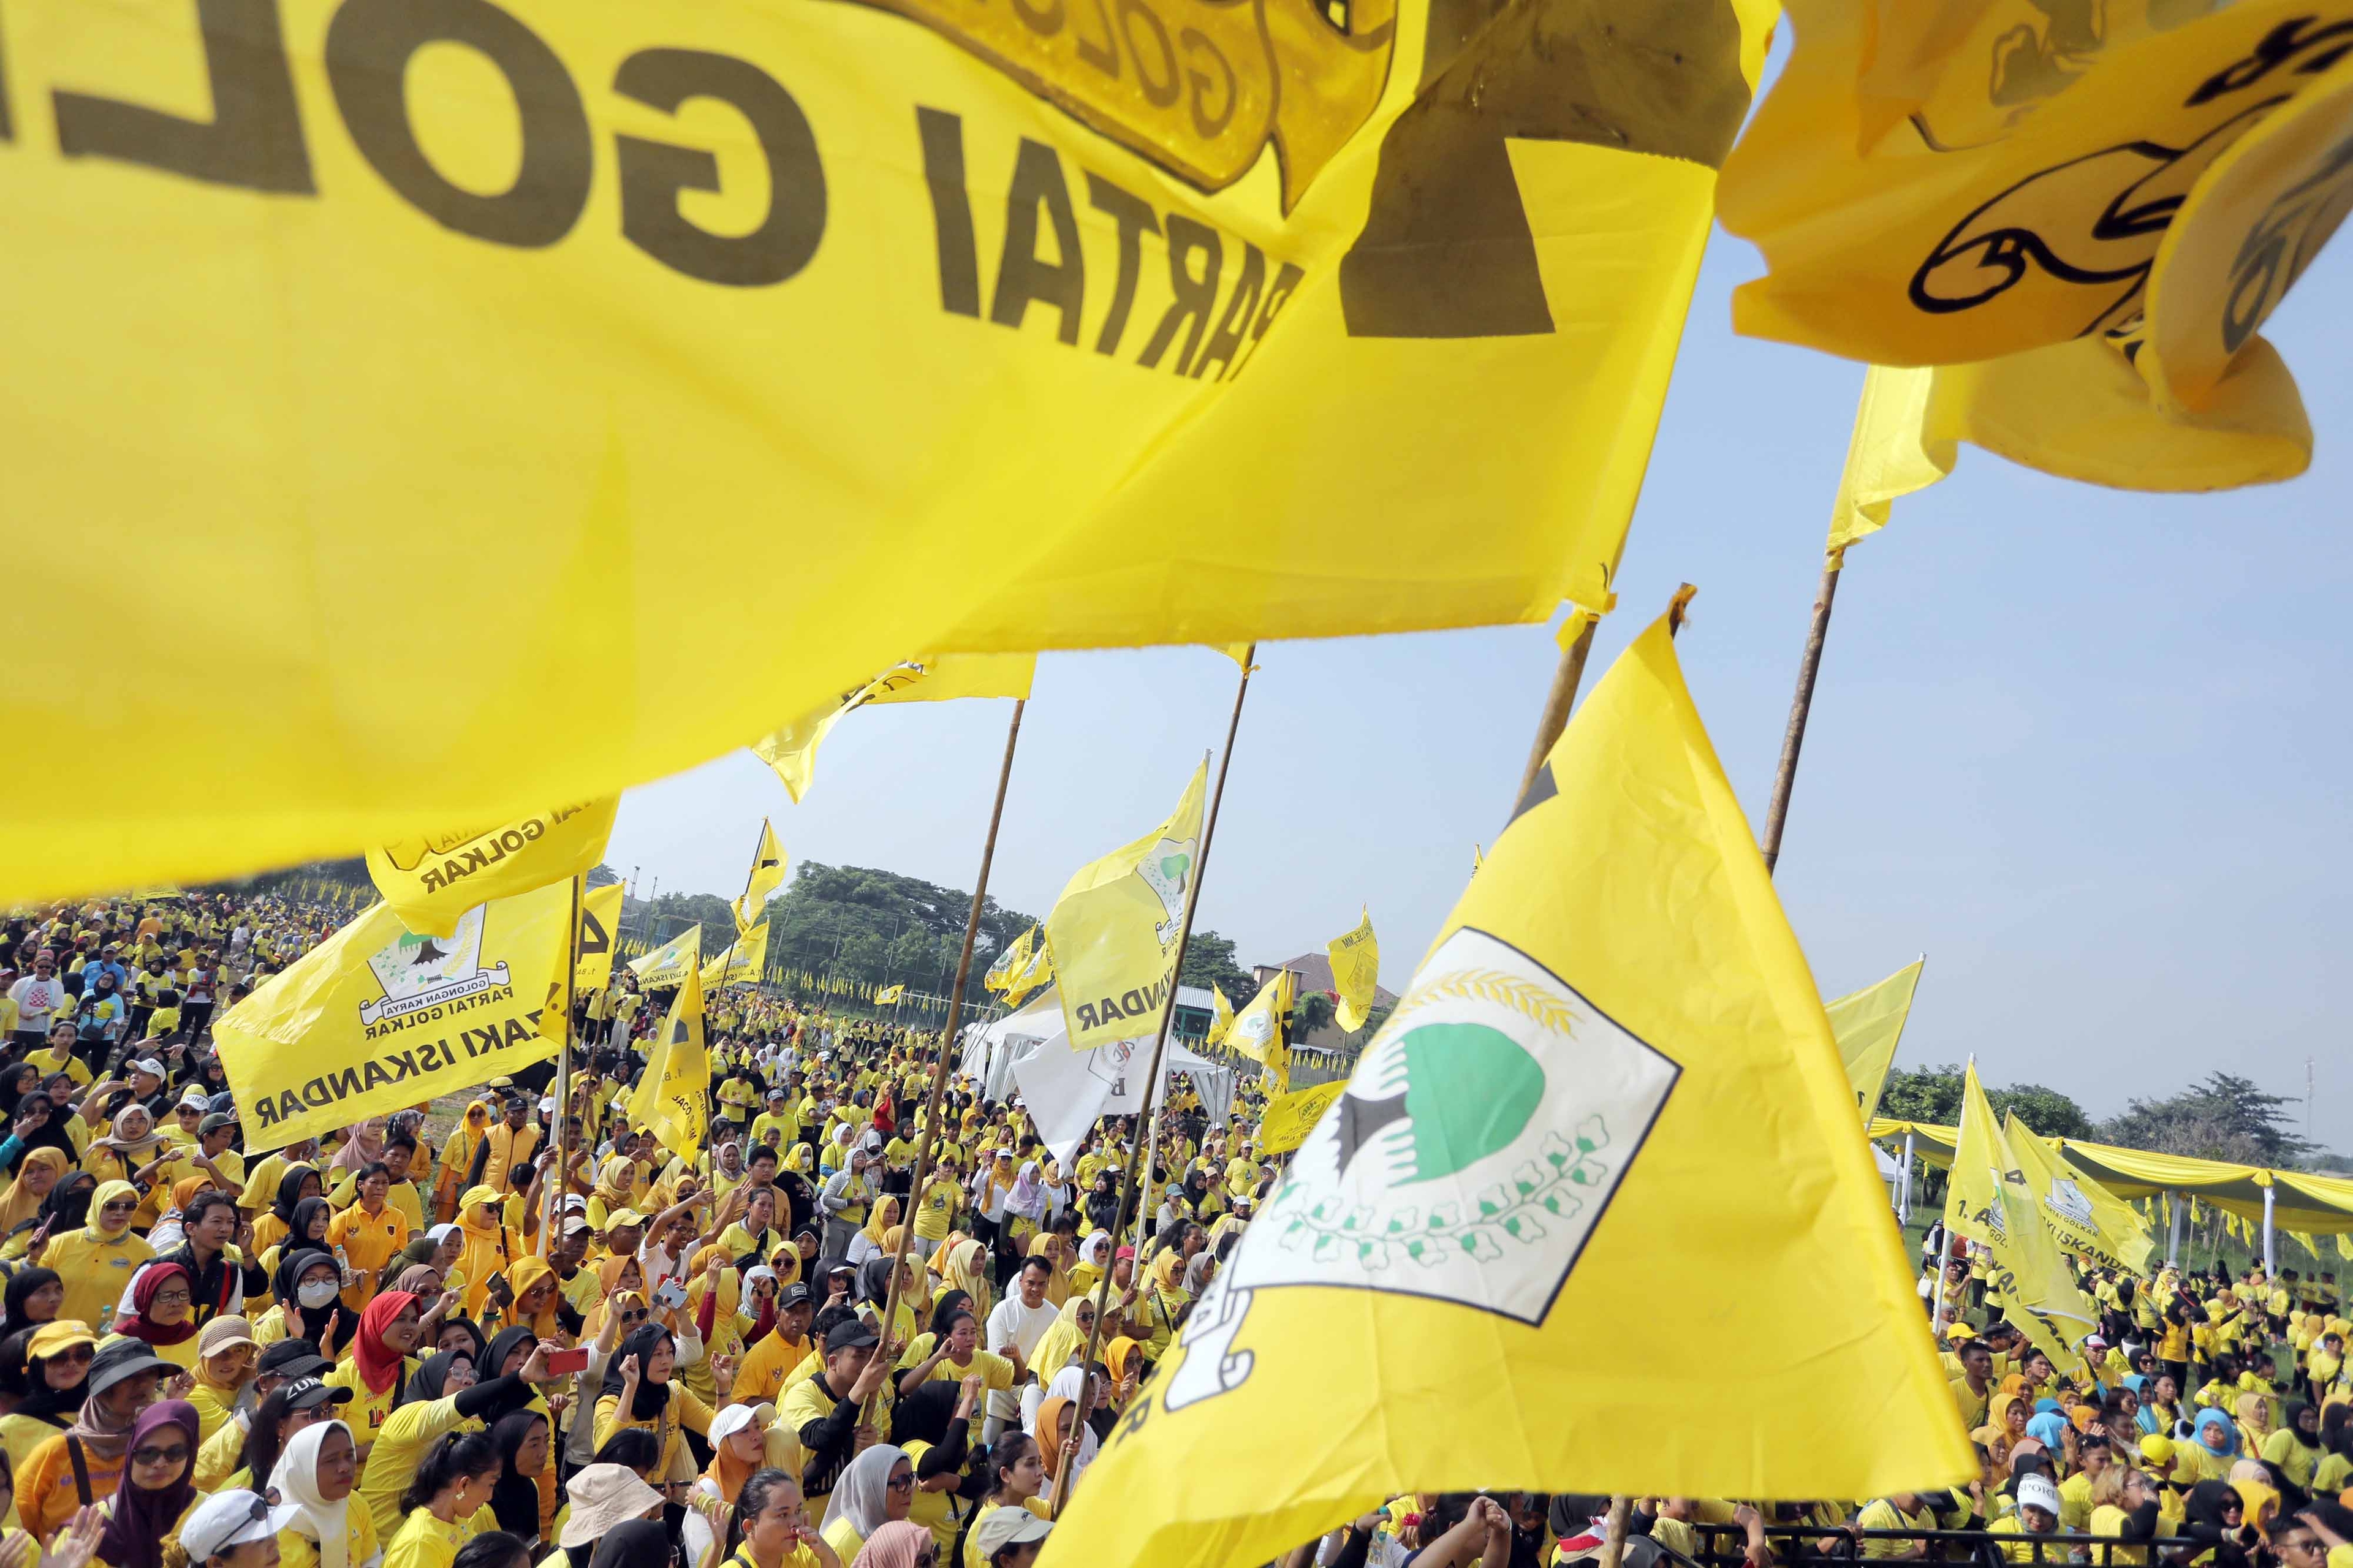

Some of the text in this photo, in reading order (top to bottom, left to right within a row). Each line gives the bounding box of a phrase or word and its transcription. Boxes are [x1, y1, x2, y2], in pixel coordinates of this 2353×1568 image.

[1958, 1200, 1968, 1219] 1.
[2063, 1217, 2099, 1238] GOLKAR
[1989, 1229, 2008, 1248] GOL
[286, 1377, 322, 1401] ZUM
[2019, 1483, 2056, 1499] SPORT
